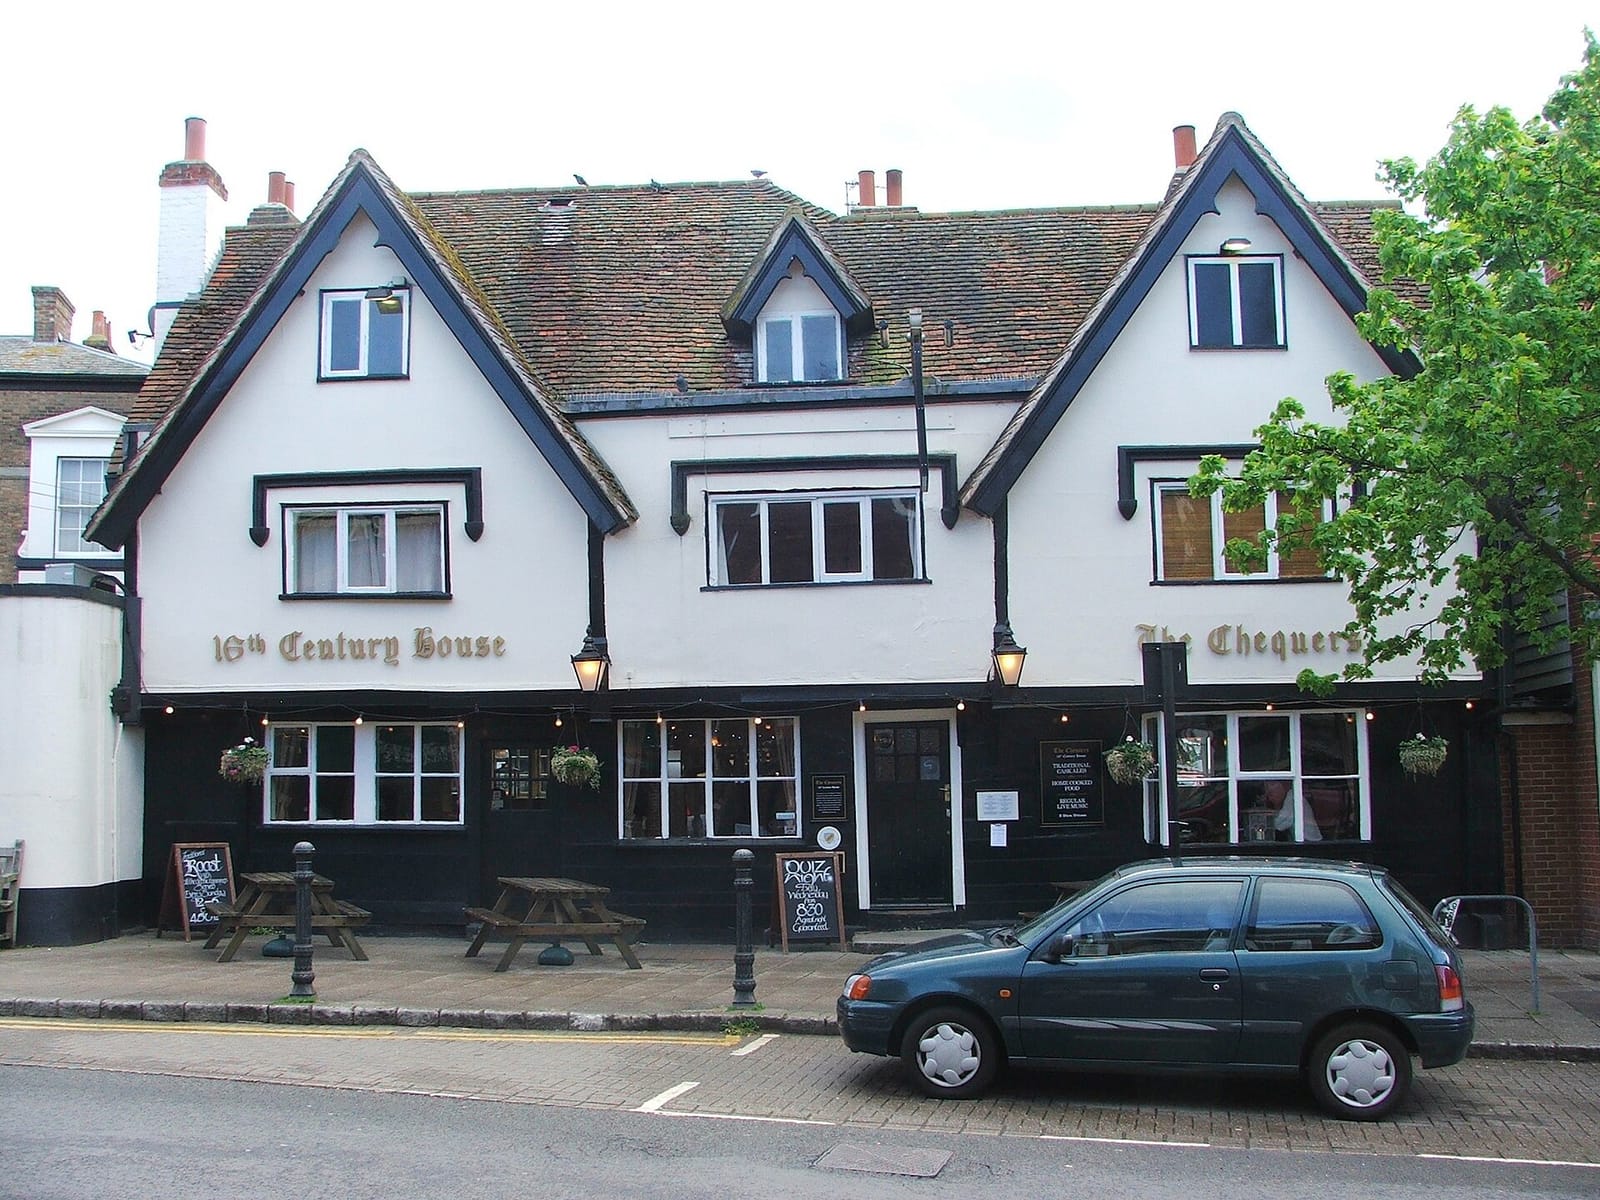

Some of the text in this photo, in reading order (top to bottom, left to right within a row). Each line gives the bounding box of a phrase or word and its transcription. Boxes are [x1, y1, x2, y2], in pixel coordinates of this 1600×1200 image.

[213, 627, 506, 665] 16th Century House
[1207, 624, 1362, 662] Chequers
[183, 854, 224, 880] Roast
